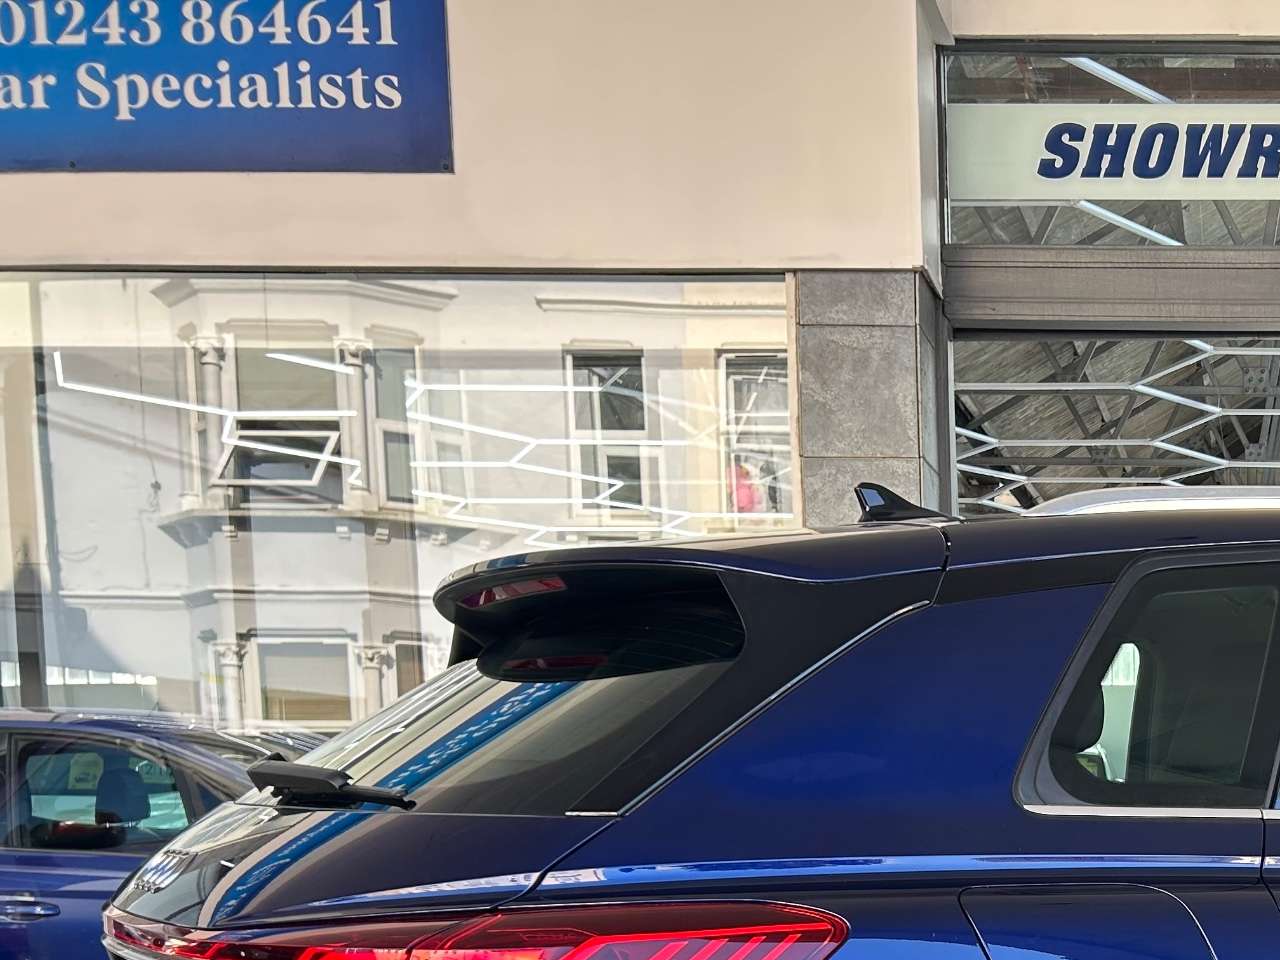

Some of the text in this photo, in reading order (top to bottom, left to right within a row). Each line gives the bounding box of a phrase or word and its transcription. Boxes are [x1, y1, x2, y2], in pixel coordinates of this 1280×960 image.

[0, 0, 398, 46] 01243 864641
[76, 59, 402, 120] Specialists
